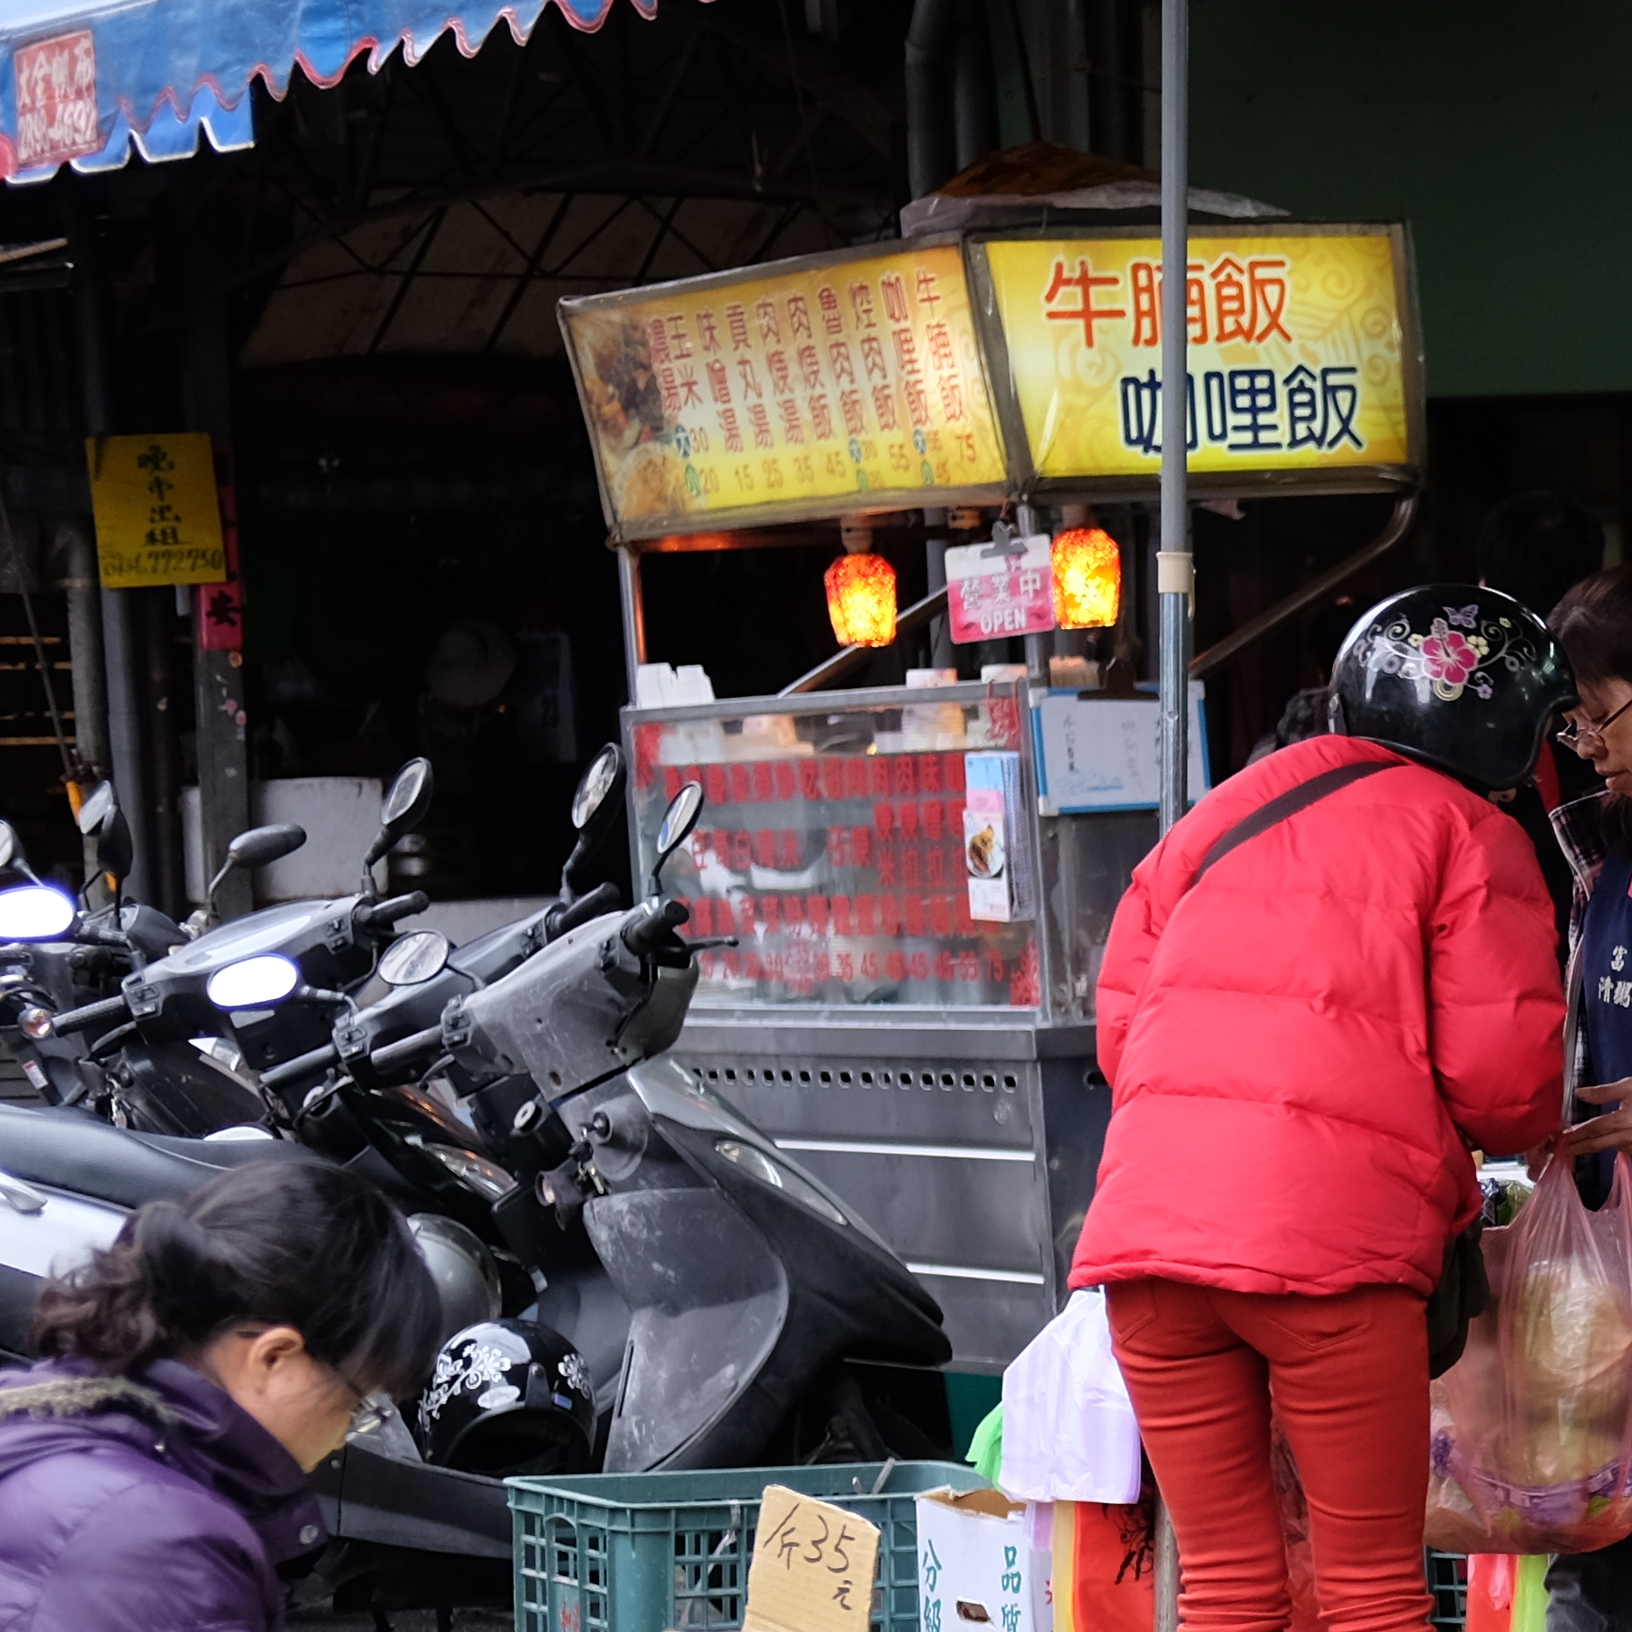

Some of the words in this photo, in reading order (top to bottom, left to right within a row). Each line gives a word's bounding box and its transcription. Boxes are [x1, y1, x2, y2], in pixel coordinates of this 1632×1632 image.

[1044, 257, 1292, 348] 牛腩飯
[726, 304, 775, 450] 貢丸湯
[1120, 364, 1363, 454] 咖哩飯
[955, 433, 978, 464] 75
[960, 571, 1041, 611] 營業中
[980, 607, 1027, 635] OPEN
